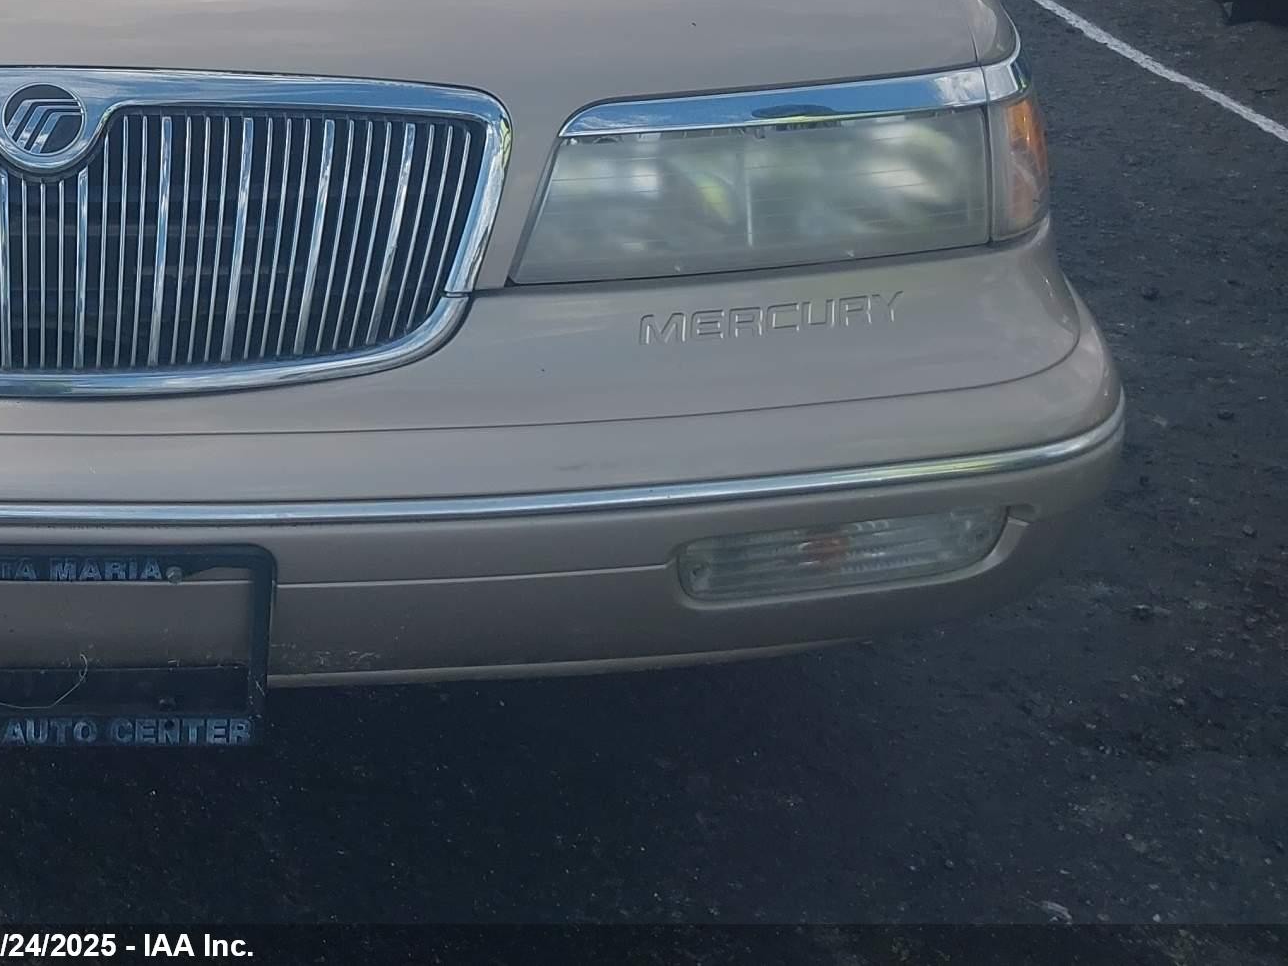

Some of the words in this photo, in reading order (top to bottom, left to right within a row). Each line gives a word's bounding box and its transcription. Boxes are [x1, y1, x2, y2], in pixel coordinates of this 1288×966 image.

[639, 290, 904, 346] MERCURY
[49, 557, 162, 581] MARIA
[0, 717, 98, 744] AUTO
[111, 718, 252, 745] CENTER
